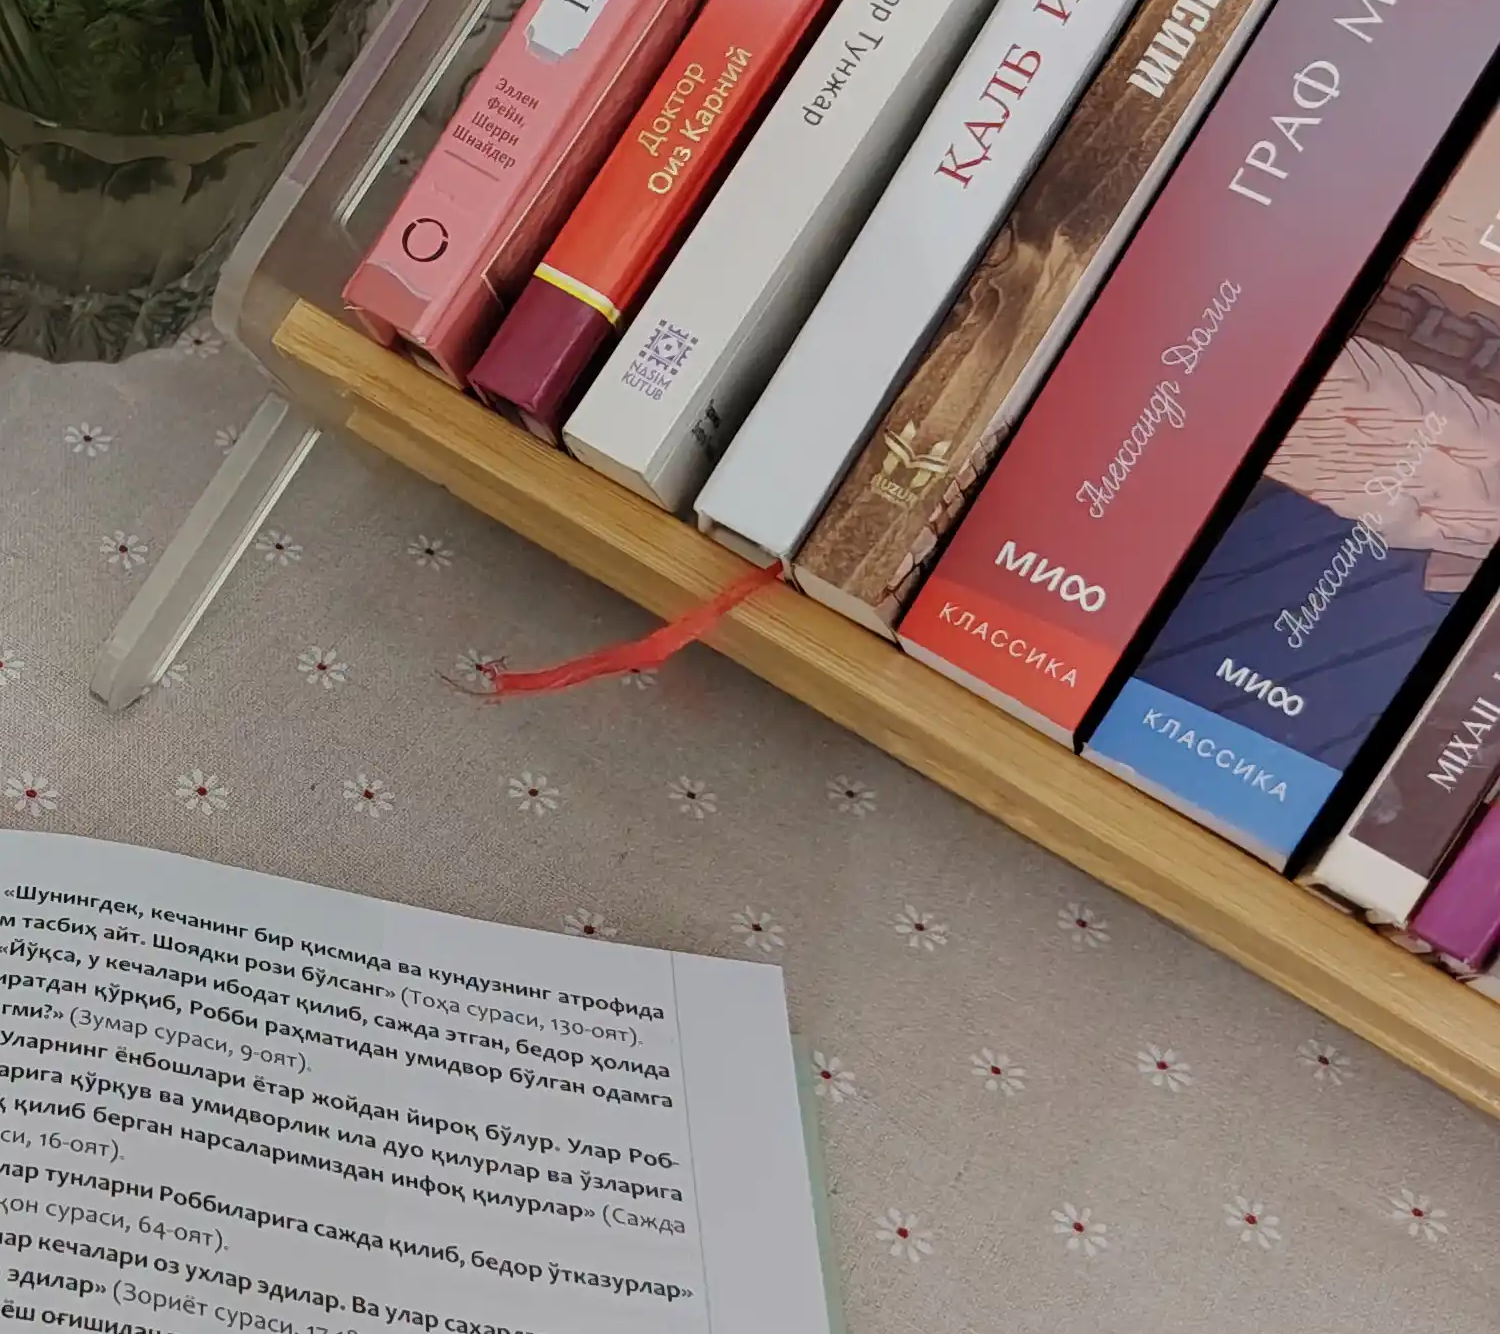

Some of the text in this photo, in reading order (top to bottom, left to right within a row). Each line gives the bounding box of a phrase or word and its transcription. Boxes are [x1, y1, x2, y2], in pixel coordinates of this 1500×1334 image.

[496, 78, 540, 110] Эллен
[633, 55, 705, 157] Доктор
[647, 45, 754, 200] Оиз Карний
[803, 32, 884, 126] Тунжар
[934, 43, 1041, 189] ҚАЛБ
[453, 126, 516, 169] Шнайдер
[472, 109, 520, 147] Шерри
[1228, 61, 1341, 207] ГРАФ
[621, 372, 663, 401] KUTUB
[630, 360, 672, 392] NASIM
[1077, 278, 1242, 519] Александр Дюма
[1276, 409, 1450, 650] Александр Дюма
[938, 600, 1079, 690] КЛАССИКА
[1142, 706, 1288, 802] КЛАССИКА
[22, 918, 97, 941] тасбиҳ
[103, 926, 145, 945] айт.
[153, 934, 238, 965] Шоядки
[245, 957, 295, 977] рози
[467, 1005, 544, 1031] сураси,
[551, 1019, 643, 1047] 130-оят).
[151, 908, 248, 938] кечанинг
[254, 927, 294, 951] бир
[301, 941, 391, 972] қисмида
[398, 962, 421, 977] ва
[429, 968, 551, 1000] кундузнинг
[558, 992, 664, 1021] атрофида
[46, 1203, 130, 1233] сураси,
[139, 1216, 229, 1253] 64-оят).
[7, 1269, 106, 1298] эдилар»
[113, 1280, 208, 1316] (Зориёт
